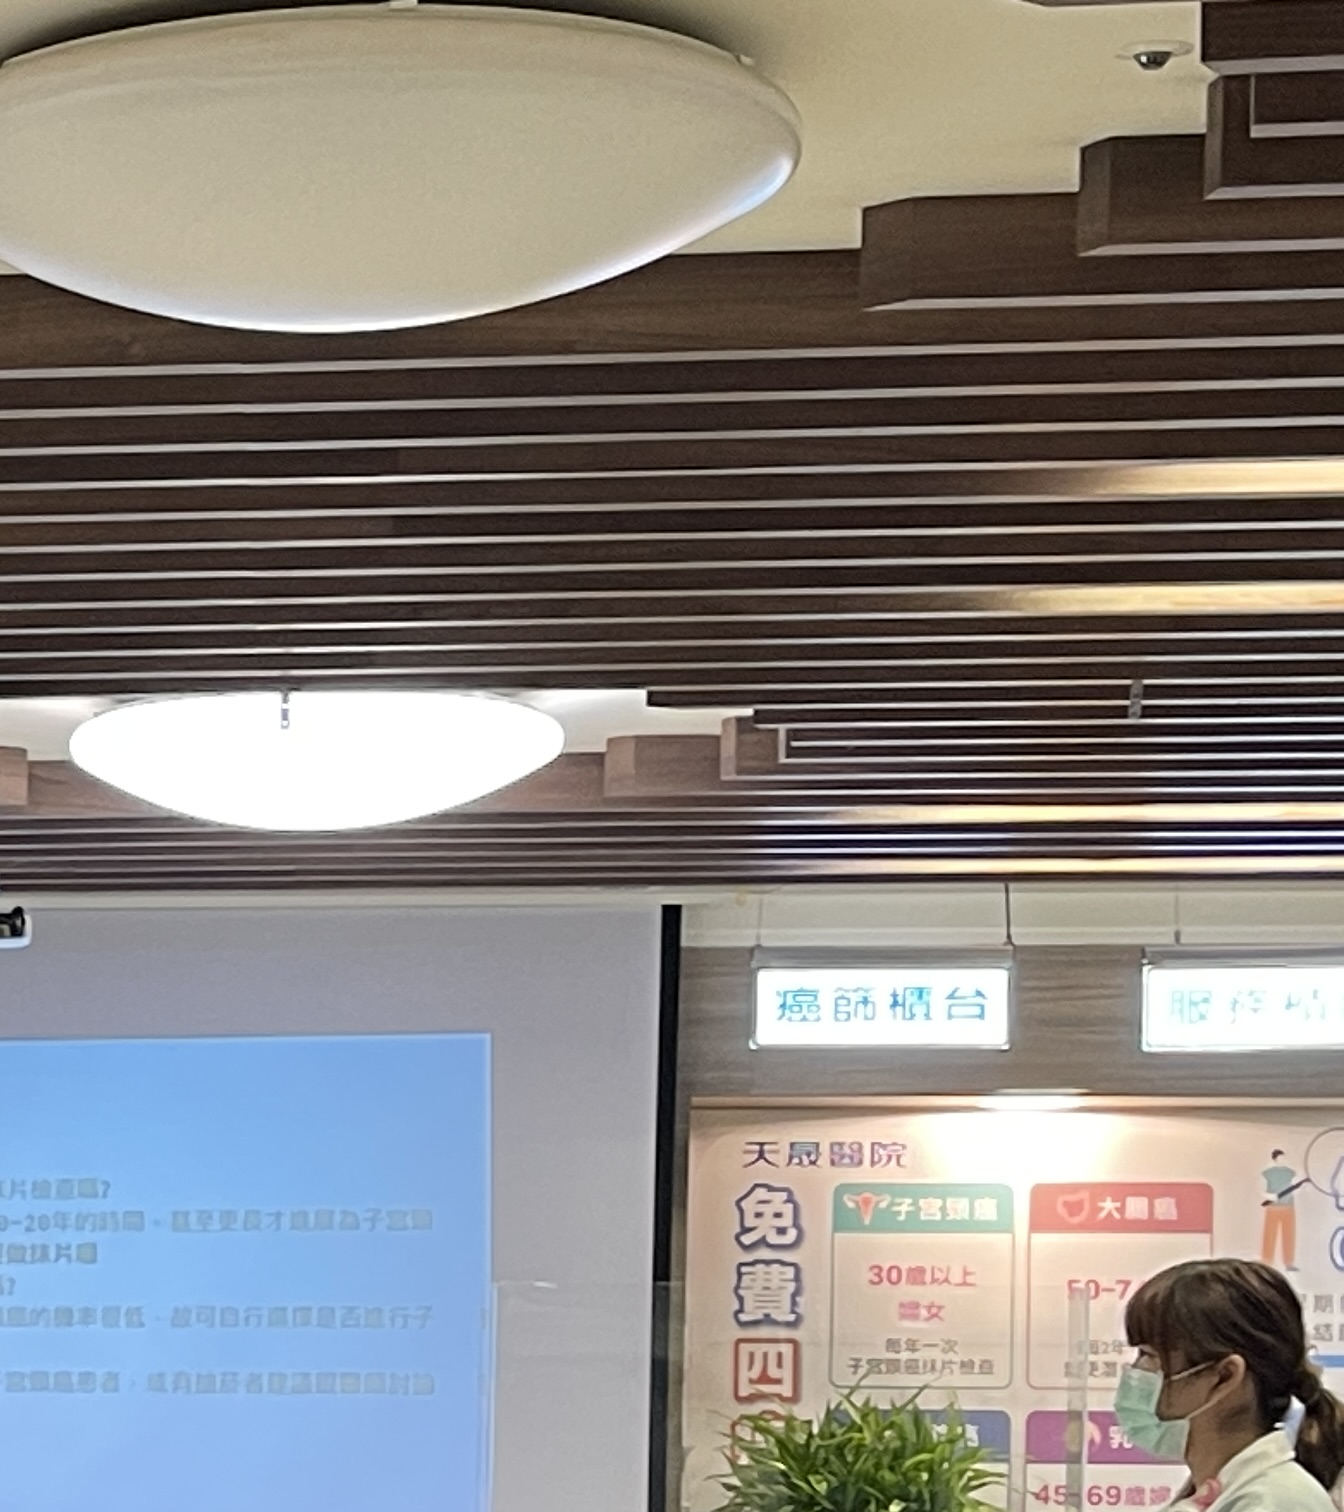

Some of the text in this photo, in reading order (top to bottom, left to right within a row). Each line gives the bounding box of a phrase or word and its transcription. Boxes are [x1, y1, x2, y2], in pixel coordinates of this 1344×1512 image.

[776, 986, 989, 1024] 癌篩櫃台
[742, 1140, 909, 1170] 天晟醫院
[890, 1196, 999, 1223] 子宮頸癌
[1096, 1196, 1179, 1222] 大腸癌
[867, 1264, 977, 1288] 30歲以上
[897, 1300, 946, 1322] 婦女
[885, 1337, 960, 1355] 每年一次
[847, 1357, 996, 1376] 子宮頸癌抹片檢查
